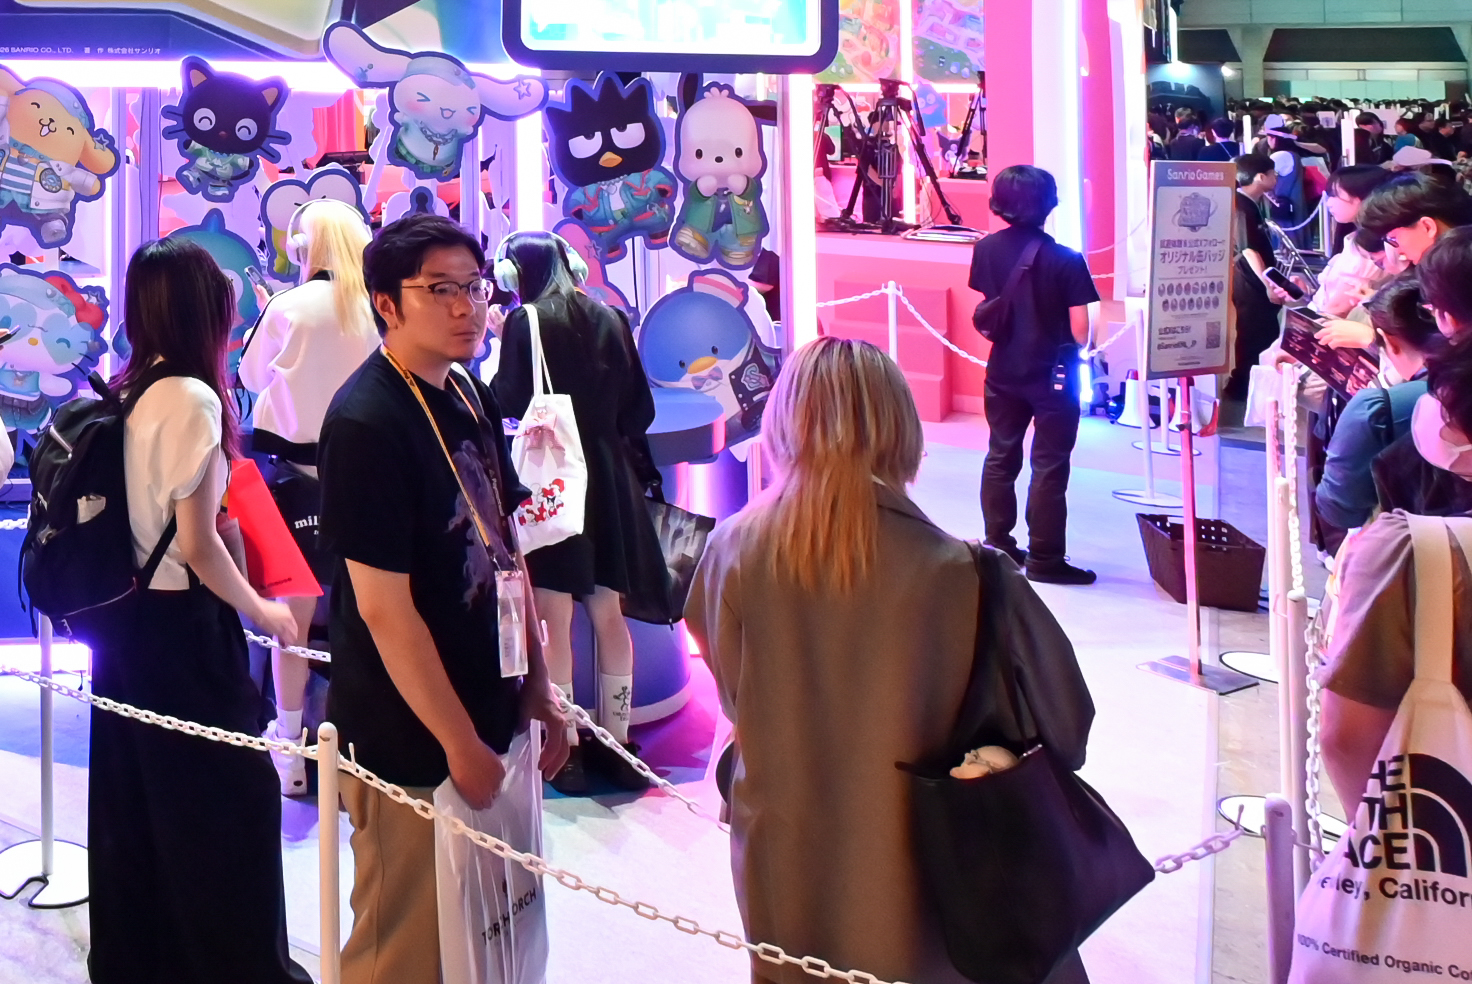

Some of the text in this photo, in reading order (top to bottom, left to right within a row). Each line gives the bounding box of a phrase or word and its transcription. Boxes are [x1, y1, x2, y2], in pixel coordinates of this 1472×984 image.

[1167, 168, 1225, 181] Sanrio Games
[294, 515, 321, 529] mil
[1379, 877, 1472, 908] Califor
[481, 911, 510, 946] TORH
[511, 887, 537, 917] ORCH
[1322, 941, 1379, 966] Certified
[1384, 955, 1443, 975] Organic
